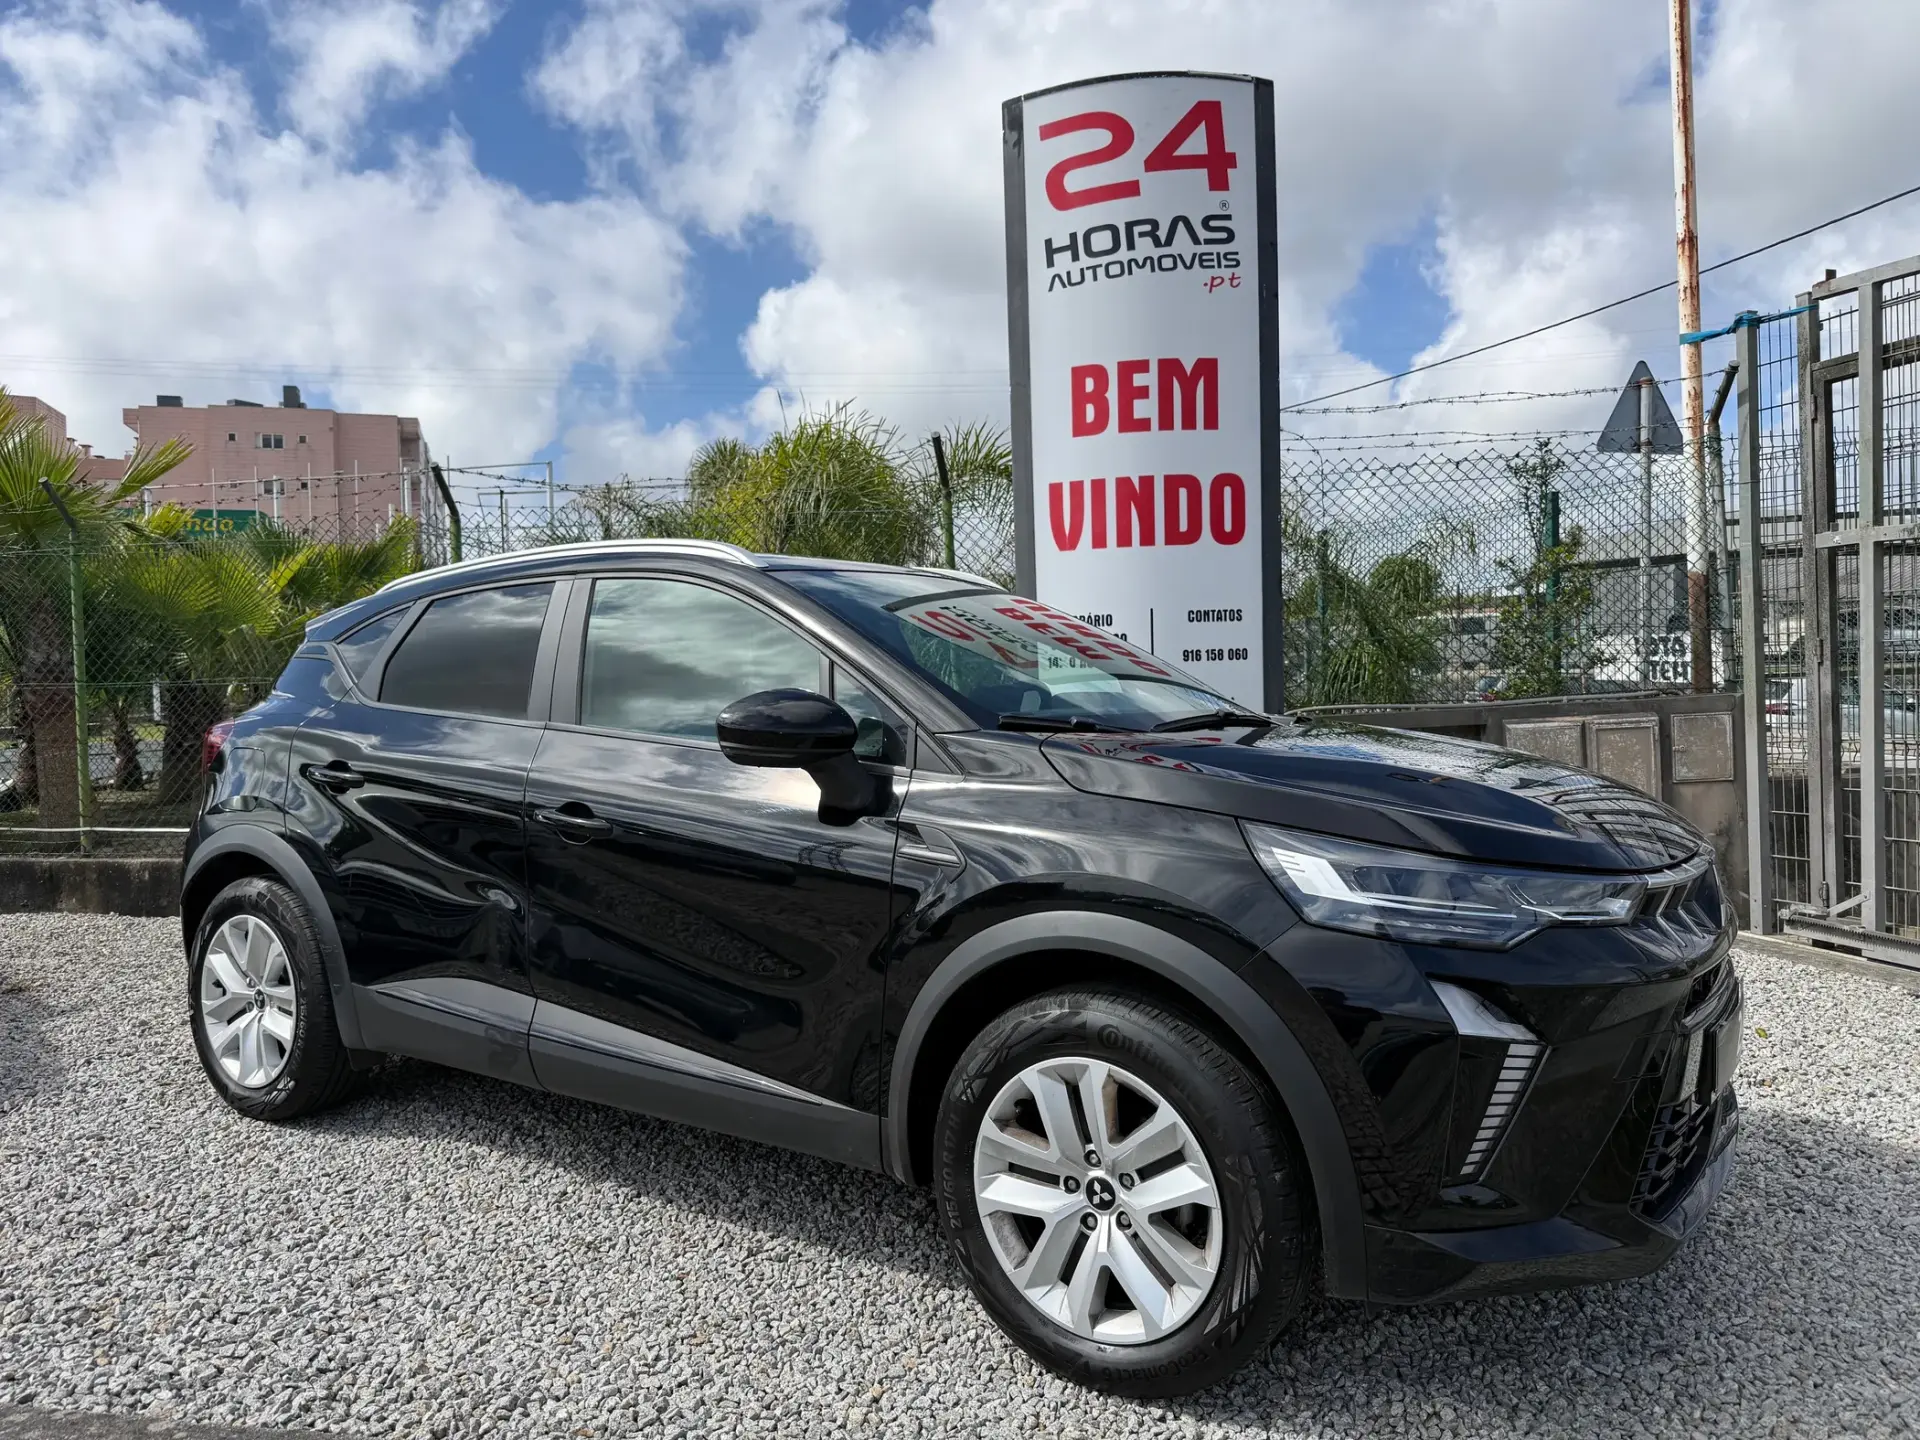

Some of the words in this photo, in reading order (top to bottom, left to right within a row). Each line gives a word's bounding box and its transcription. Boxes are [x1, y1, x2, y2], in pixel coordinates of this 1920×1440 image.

[1039, 100, 1237, 211] 24
[1044, 214, 1236, 268] HORAS
[1048, 251, 1241, 292] AUTOMOVEIS
[1203, 272, 1241, 293] .pt
[1071, 358, 1219, 438] BEM
[1049, 473, 1246, 552] VINDO
[1187, 608, 1243, 623] CONTATOS
[1182, 649, 1202, 662] 916
[1205, 648, 1224, 662] 158
[1227, 647, 1248, 661] 060
